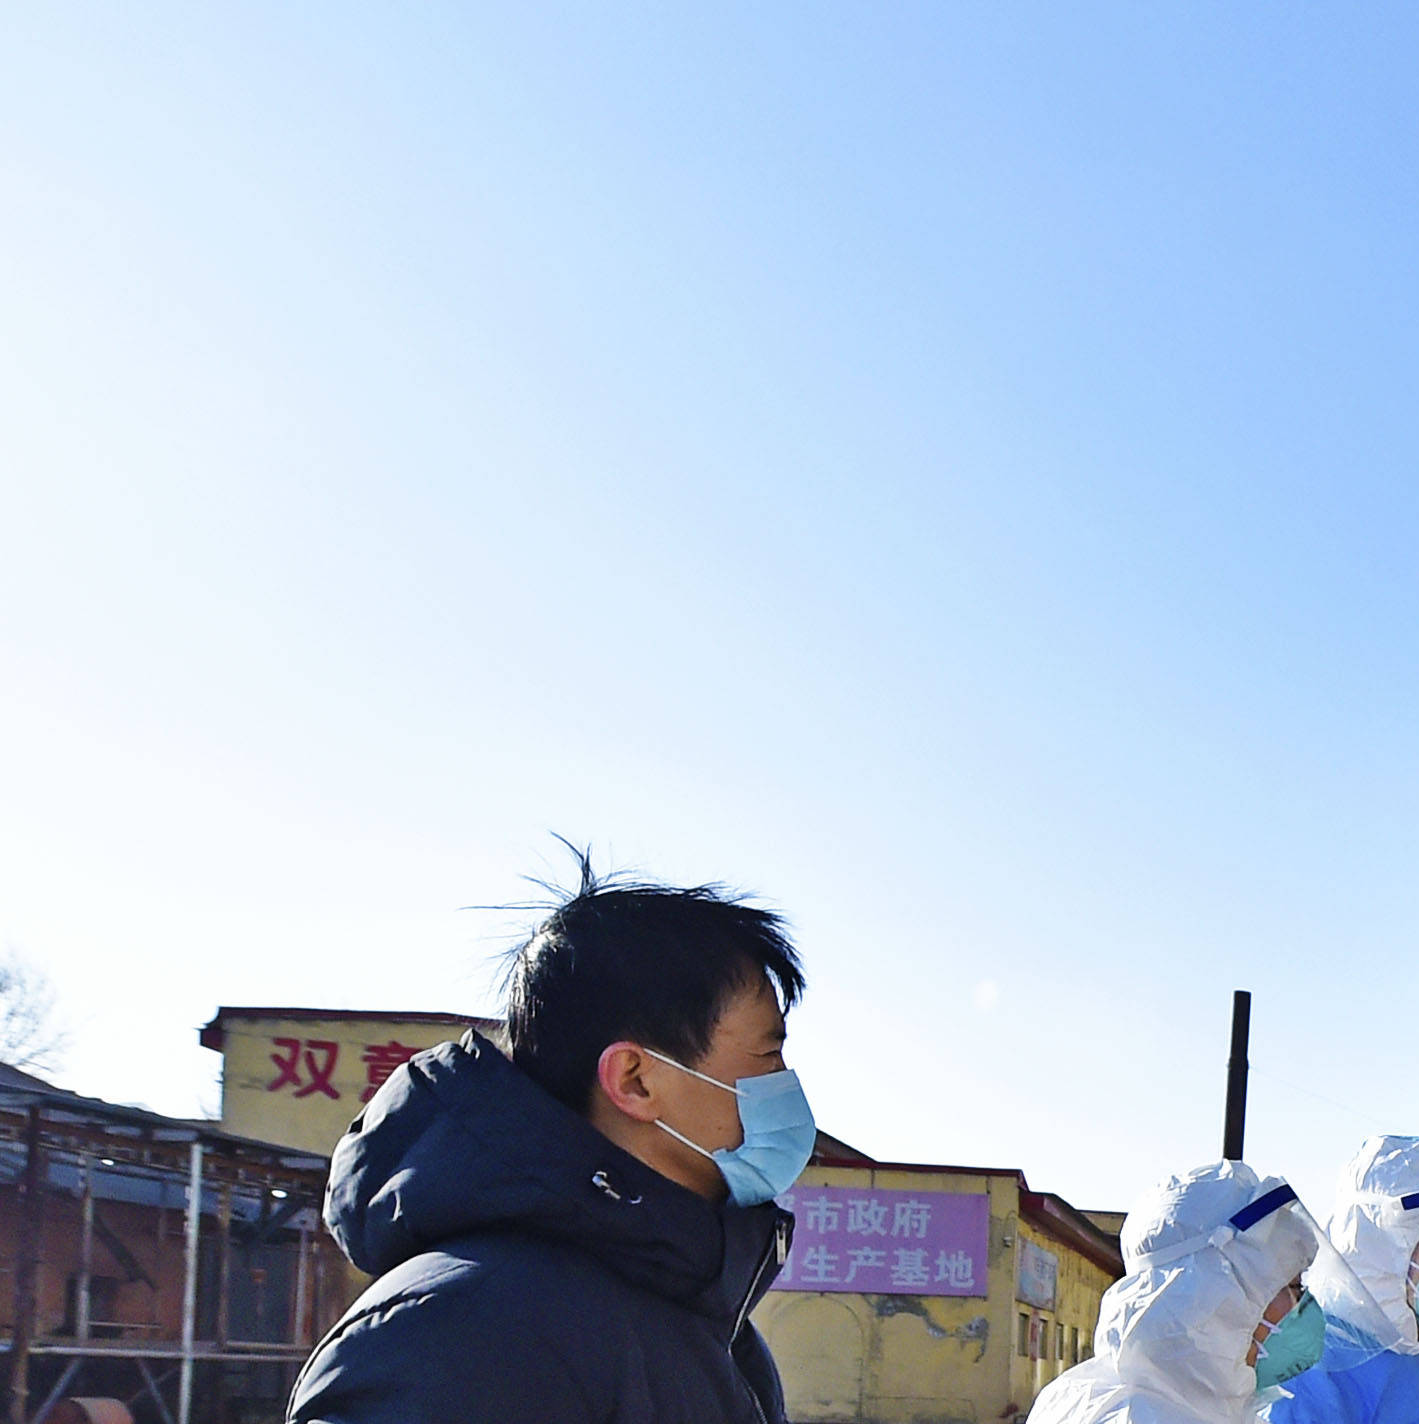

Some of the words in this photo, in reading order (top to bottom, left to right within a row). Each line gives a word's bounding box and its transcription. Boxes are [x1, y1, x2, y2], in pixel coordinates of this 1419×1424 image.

[779, 1193, 932, 1239] 市政府
[782, 1246, 975, 1288] 生产基地
